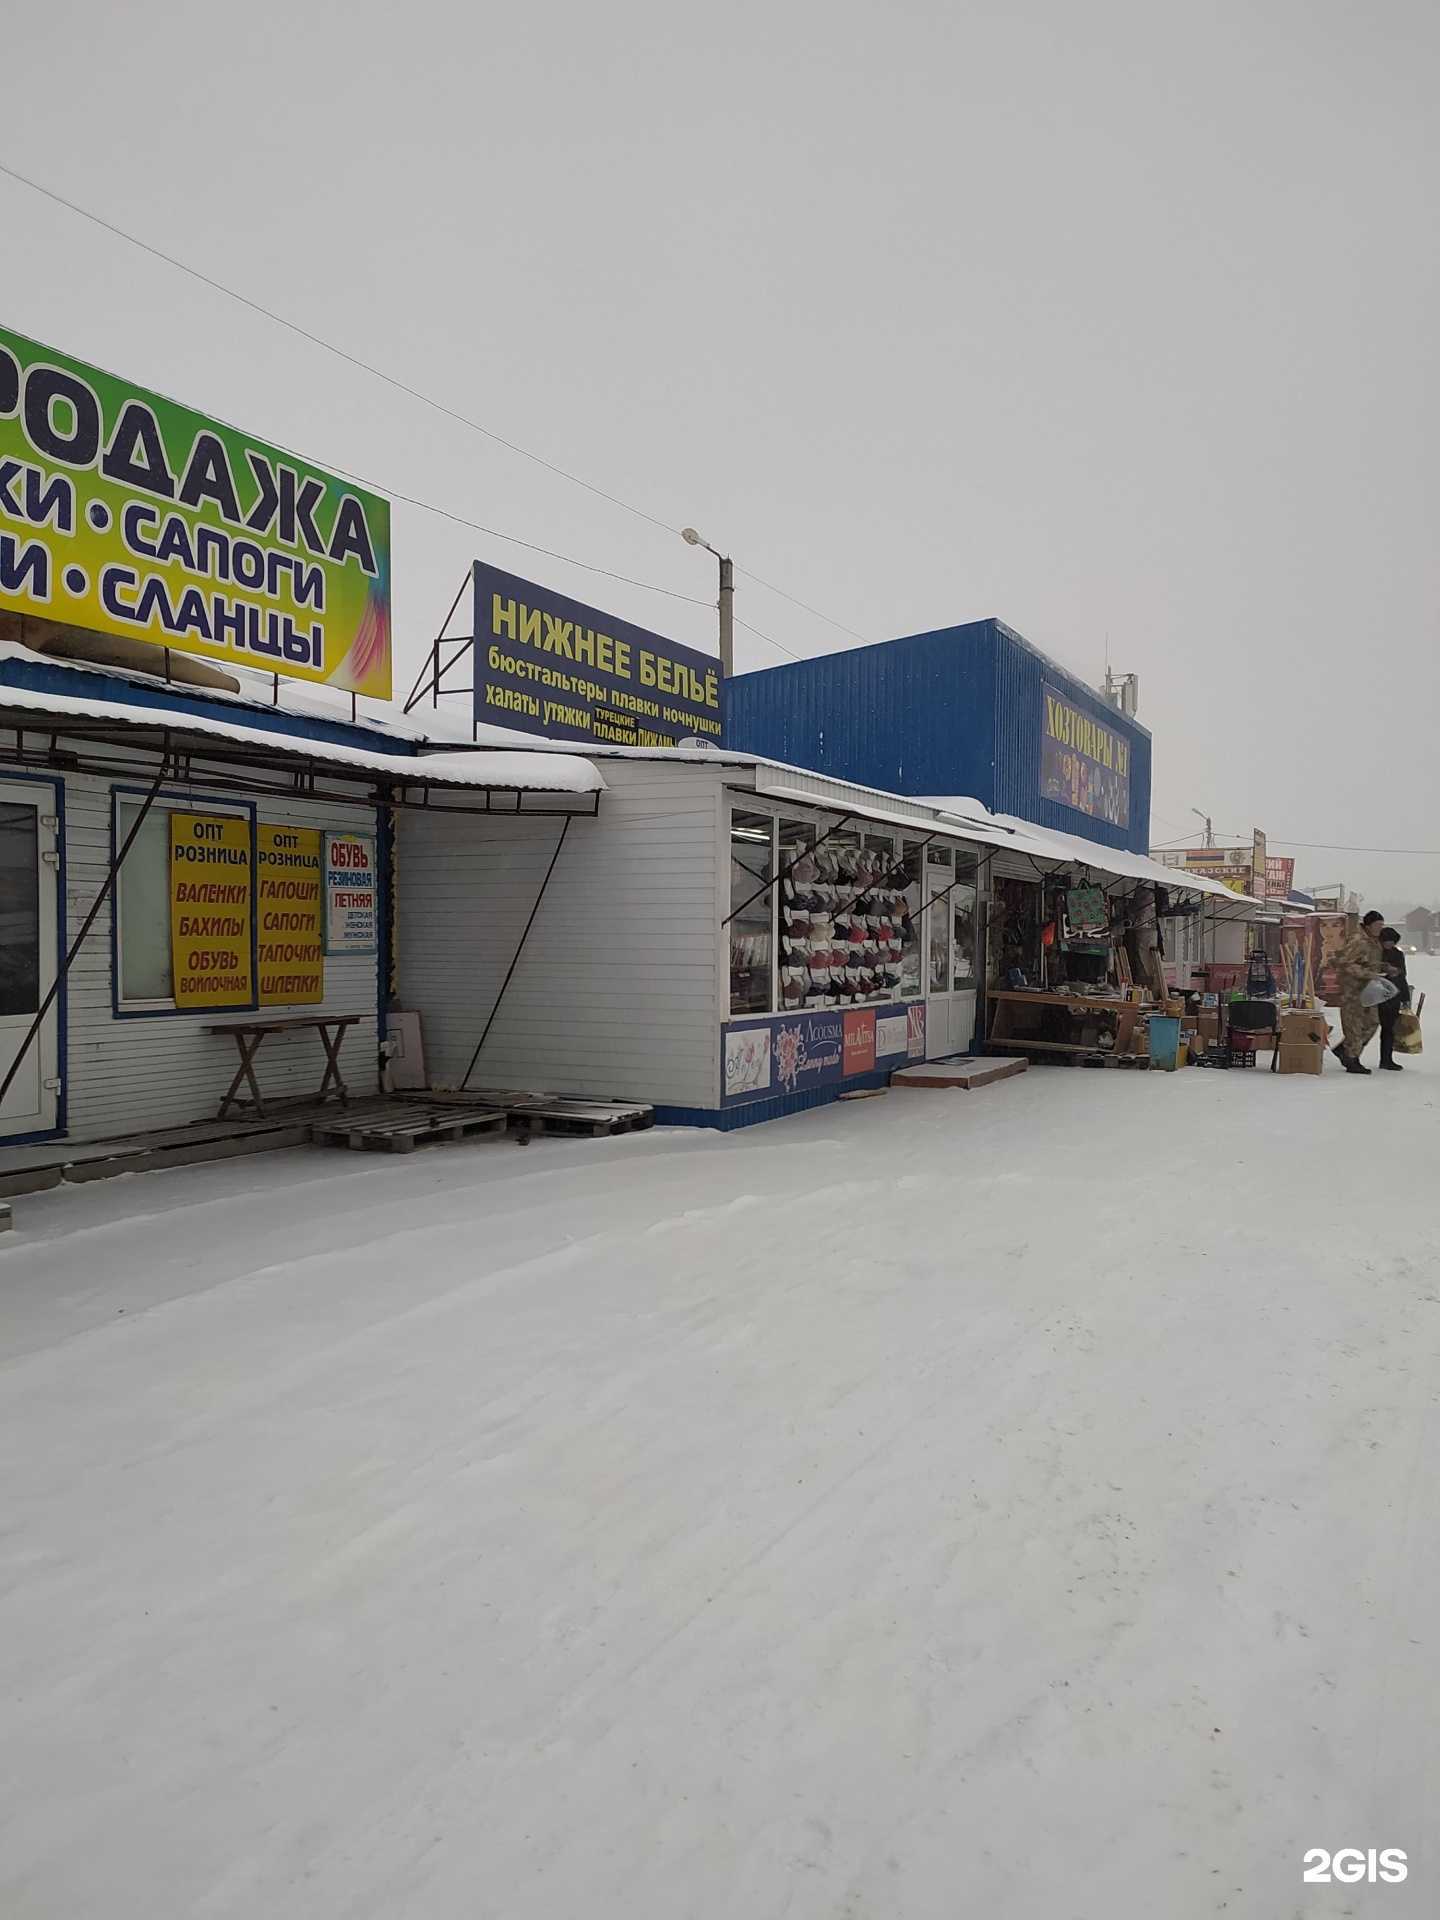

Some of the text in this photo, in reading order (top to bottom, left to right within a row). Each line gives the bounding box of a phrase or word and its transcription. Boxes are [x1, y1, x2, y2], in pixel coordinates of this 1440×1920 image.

[0, 349, 377, 574] ОДАЖА
[124, 504, 324, 610] САПОГИ
[102, 567, 322, 667] СЛАНЦЫ
[491, 593, 719, 709] НИЖНЕЕ БЕЛЬЁ
[488, 646, 722, 736] бюстгальтеры плавки ночнушки
[485, 683, 591, 730] халаты утяжки
[595, 707, 635, 728] ТУРЕЦКИЕ
[593, 720, 637, 746] ПЛАВКИ
[1046, 695, 1113, 769] ХОЗТОВАРЫ
[193, 823, 223, 840] ОПТ
[273, 834, 298, 848] ОПТ
[175, 845, 248, 865] РОЗНИЦА
[259, 852, 319, 868] РОЗНИЦА
[331, 842, 368, 868] ОБУВЬ
[328, 871, 372, 887] РЕЗИНОВАЯ
[176, 882, 247, 904] ВАЛЕНКИ
[259, 880, 319, 901] ГАЛОШИ
[334, 893, 373, 908] ЛЕТНЯЯ
[179, 916, 244, 937] БАХИЛЫ
[263, 912, 315, 931] САПОГИ
[188, 951, 238, 970] ОБУВЬ
[258, 944, 321, 962] ТАПОЧКИ
[261, 976, 320, 994] ШЛЕПКИ
